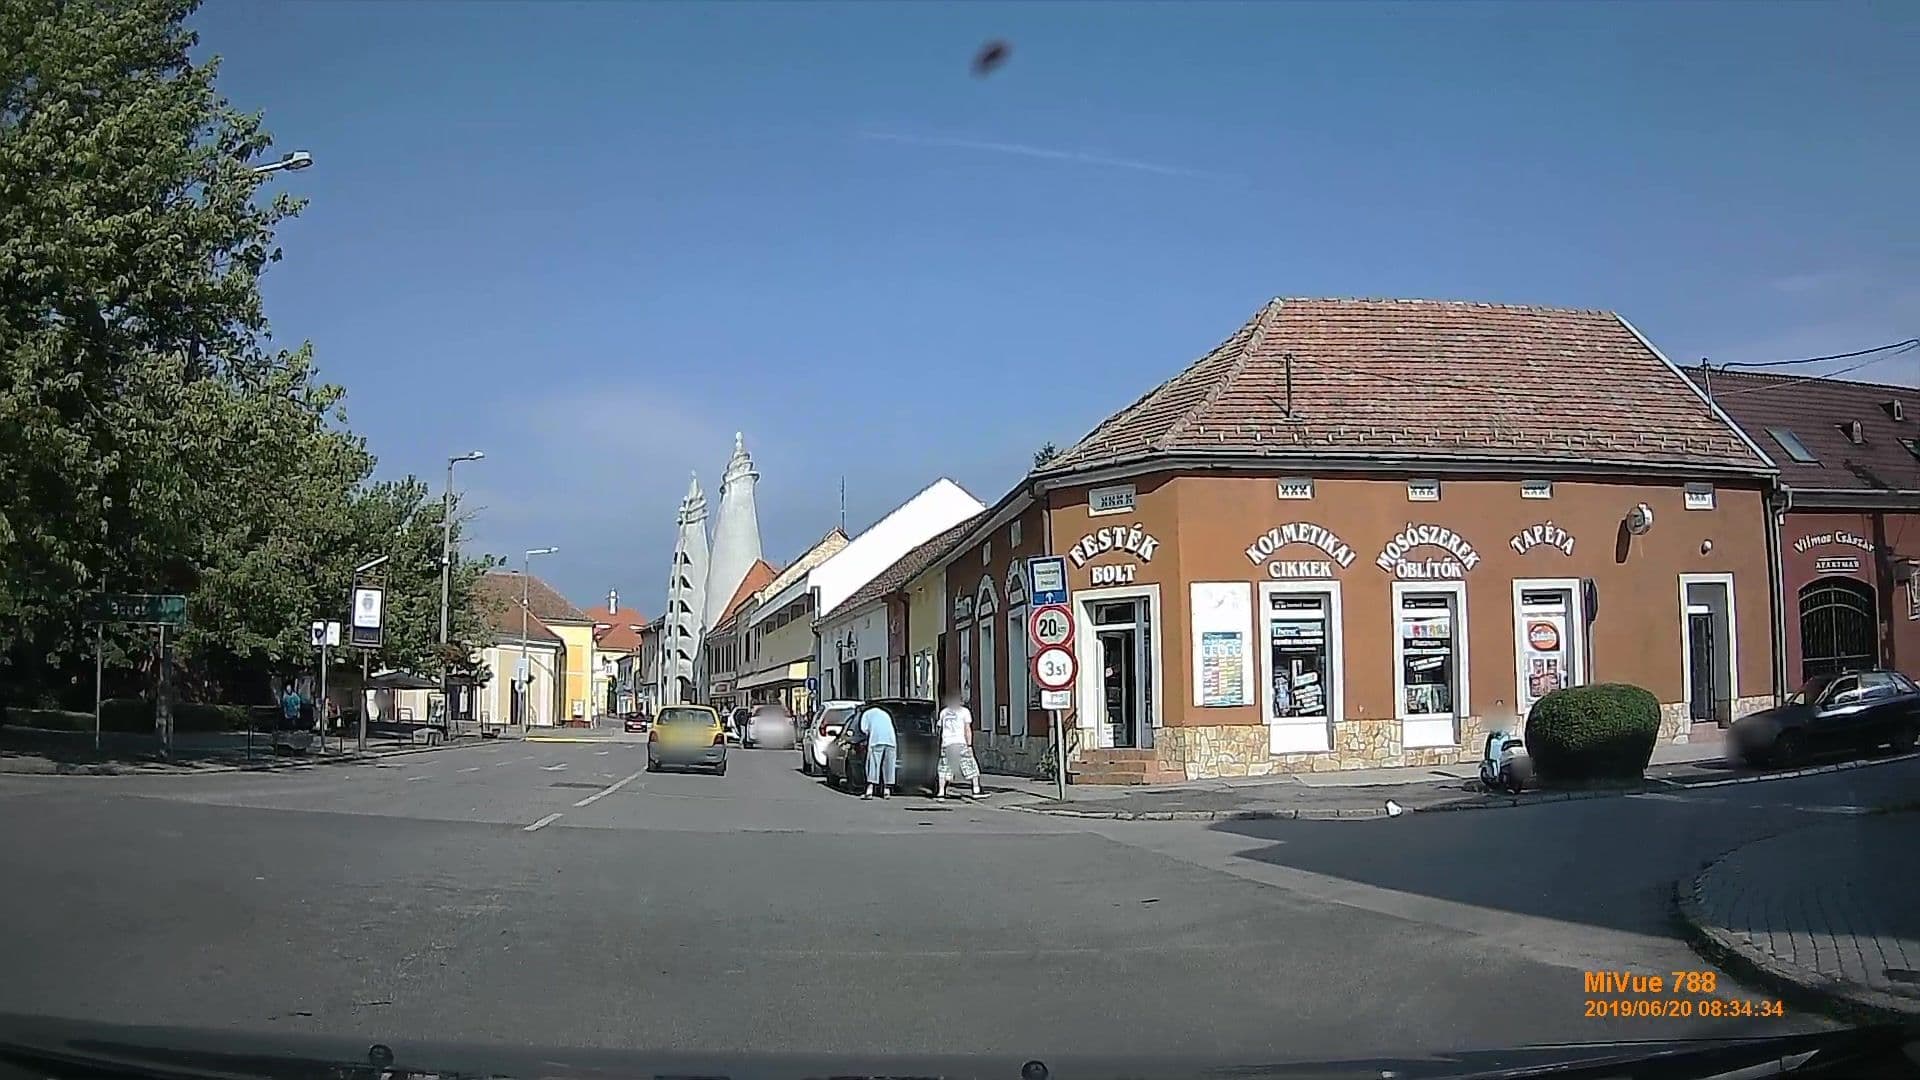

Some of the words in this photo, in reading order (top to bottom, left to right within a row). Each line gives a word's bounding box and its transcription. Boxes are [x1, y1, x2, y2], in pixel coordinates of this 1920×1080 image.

[1069, 523, 1160, 568] FESTÉK
[1245, 522, 1357, 568] KOZMETIKAI
[1376, 522, 1481, 572] MOSÓSZEREK
[1509, 520, 1576, 555] TAPÉTA
[1091, 564, 1136, 584] BOLT
[1269, 561, 1332, 577] CIKKEK
[1039, 618, 1057, 637] 20
